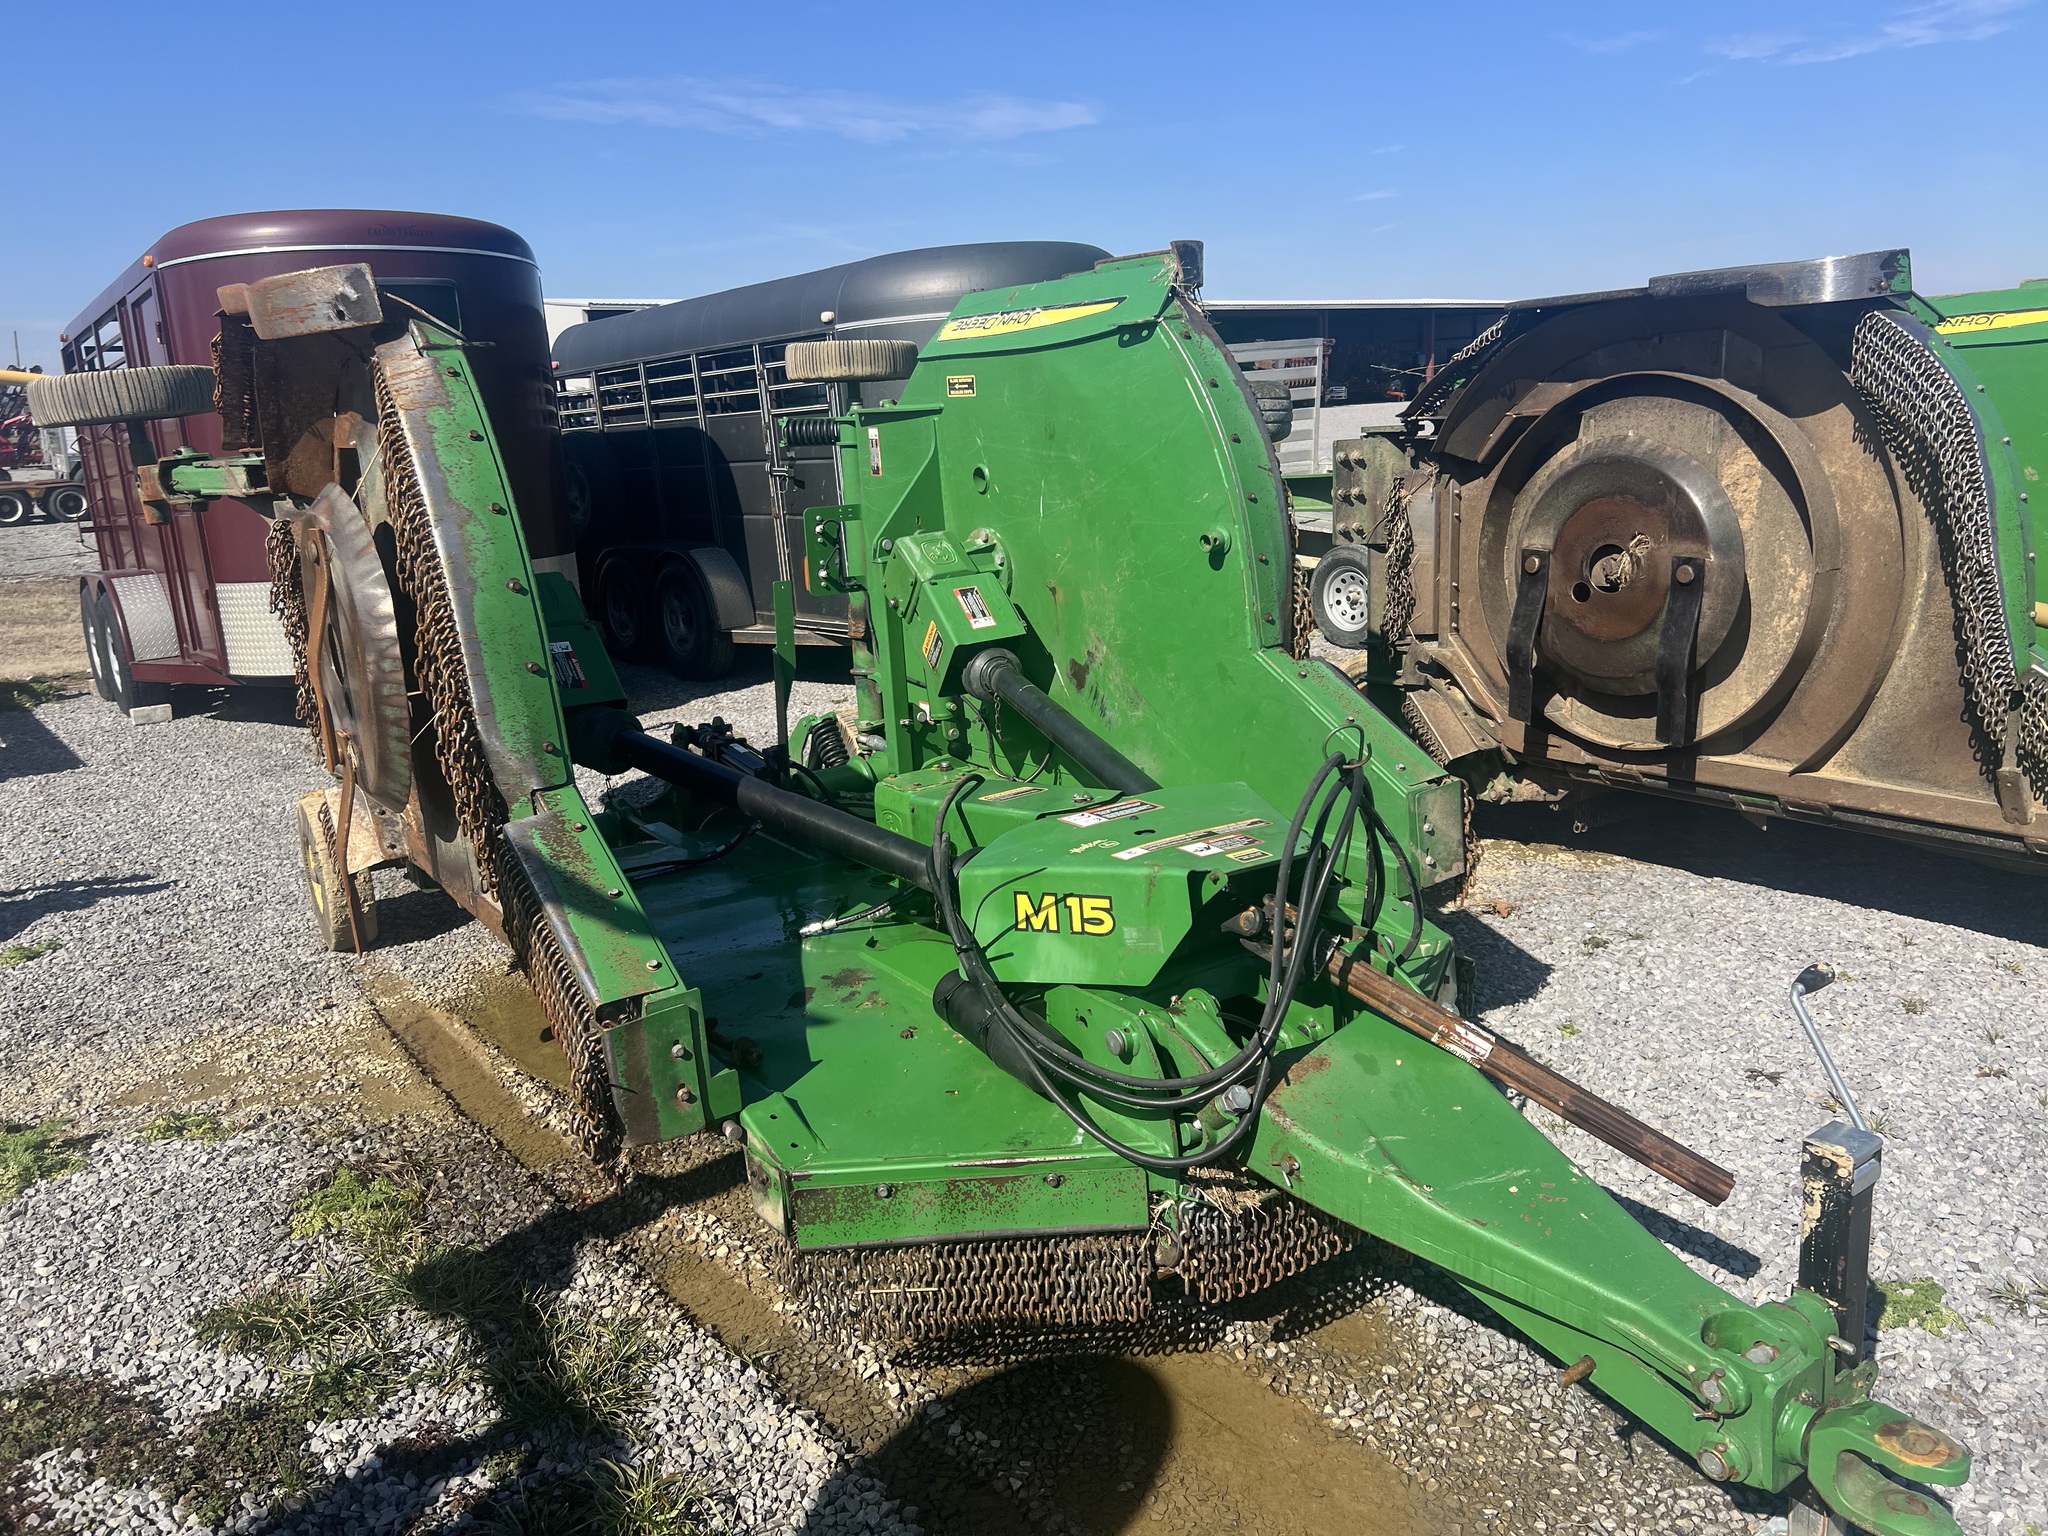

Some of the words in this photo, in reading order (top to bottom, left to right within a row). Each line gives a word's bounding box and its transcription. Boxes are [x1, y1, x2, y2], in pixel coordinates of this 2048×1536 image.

[952, 316, 998, 331] DEERE
[998, 312, 1040, 327] JOHN
[1942, 313, 2004, 328] JOHN
